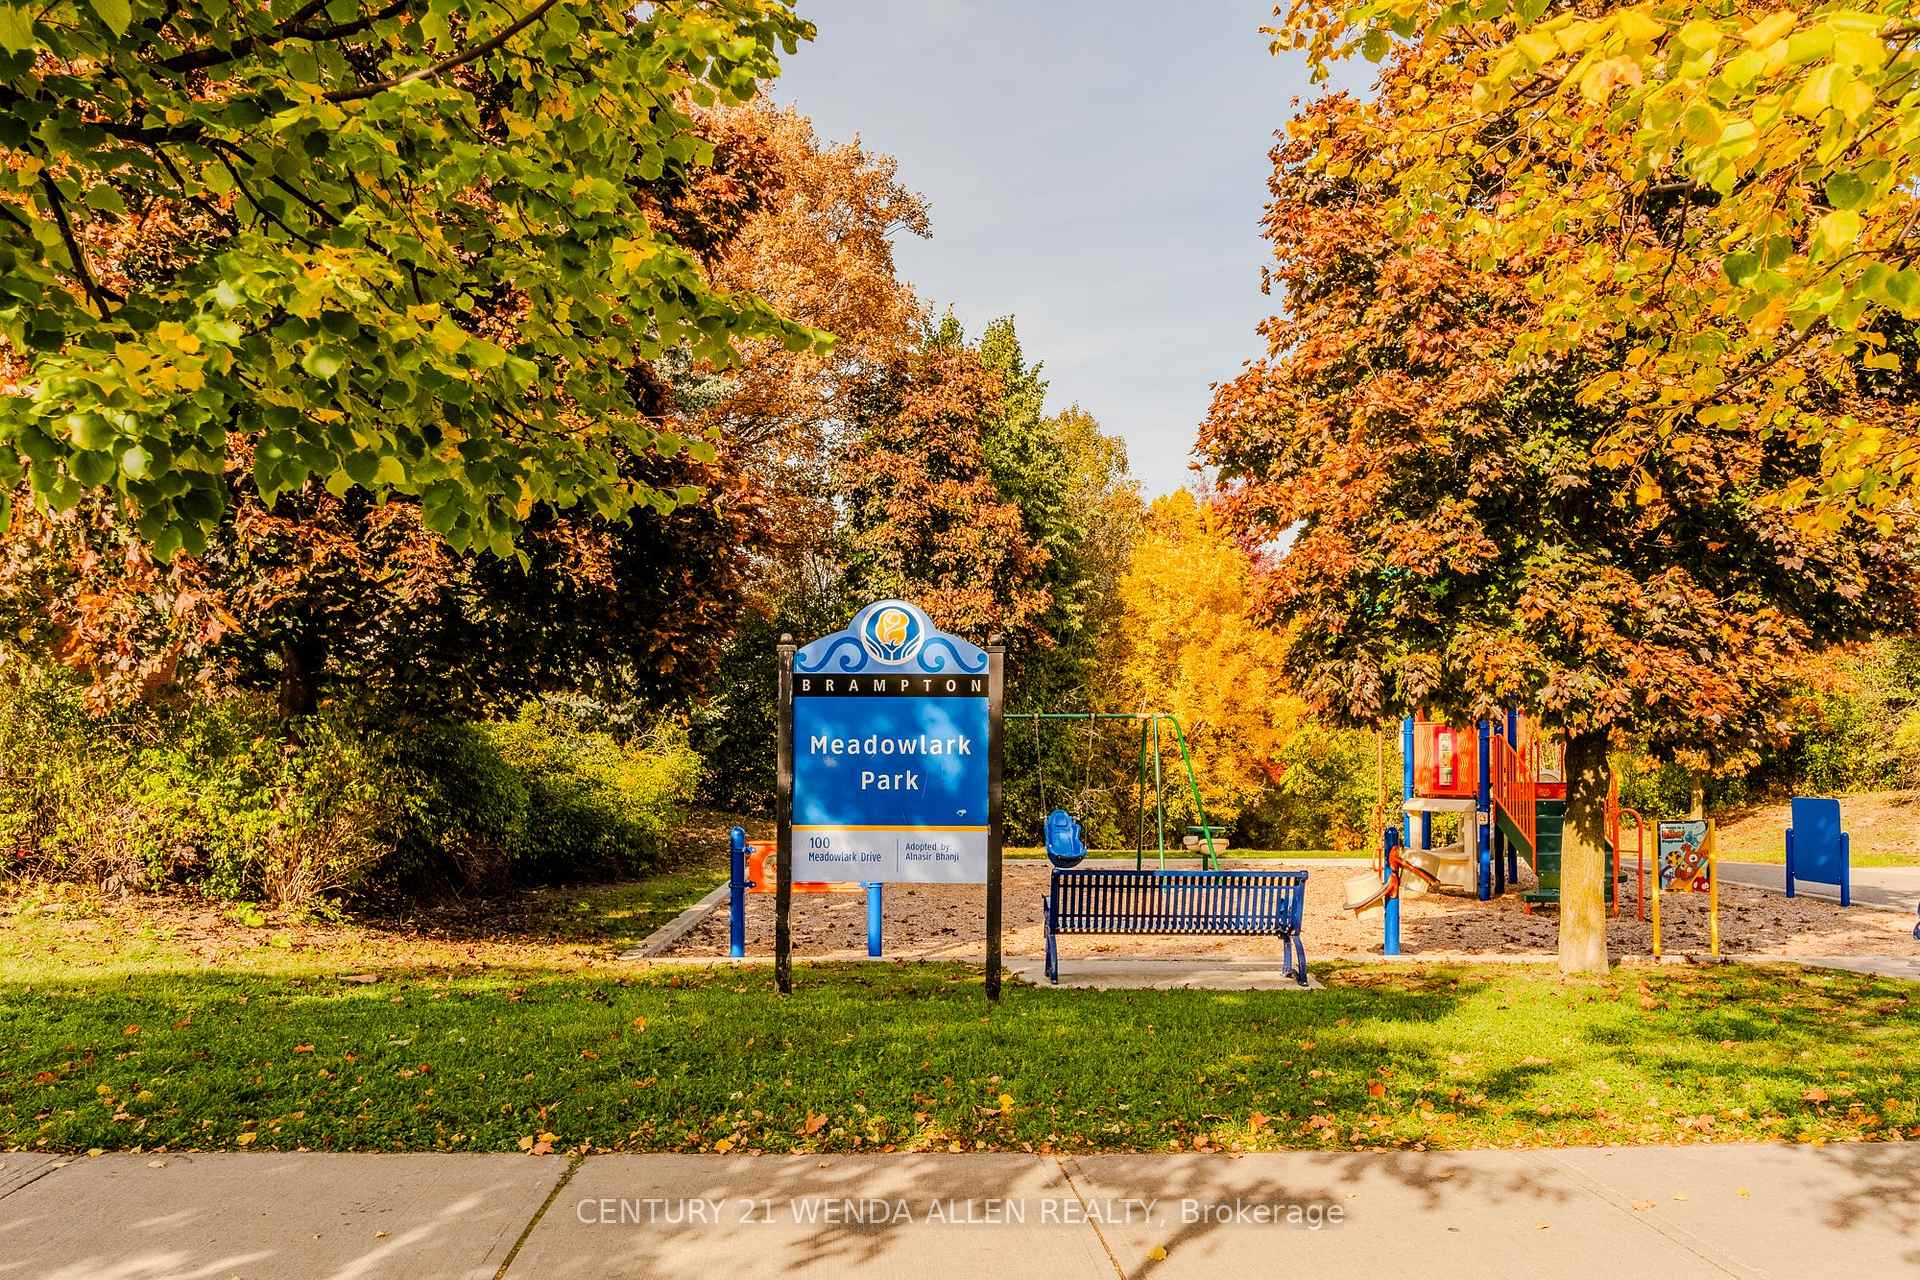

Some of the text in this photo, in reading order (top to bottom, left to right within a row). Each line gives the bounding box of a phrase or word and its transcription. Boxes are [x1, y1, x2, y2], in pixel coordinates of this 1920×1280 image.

[802, 679, 981, 692] BRAMPTON
[810, 735, 971, 755] Meadowlark
[861, 771, 919, 791] Park
[809, 837, 830, 848] 100
[905, 842, 937, 852] Adopted
[808, 852, 882, 862] Meadowlark Drive
[905, 852, 960, 863] Alnasir Bhanji
